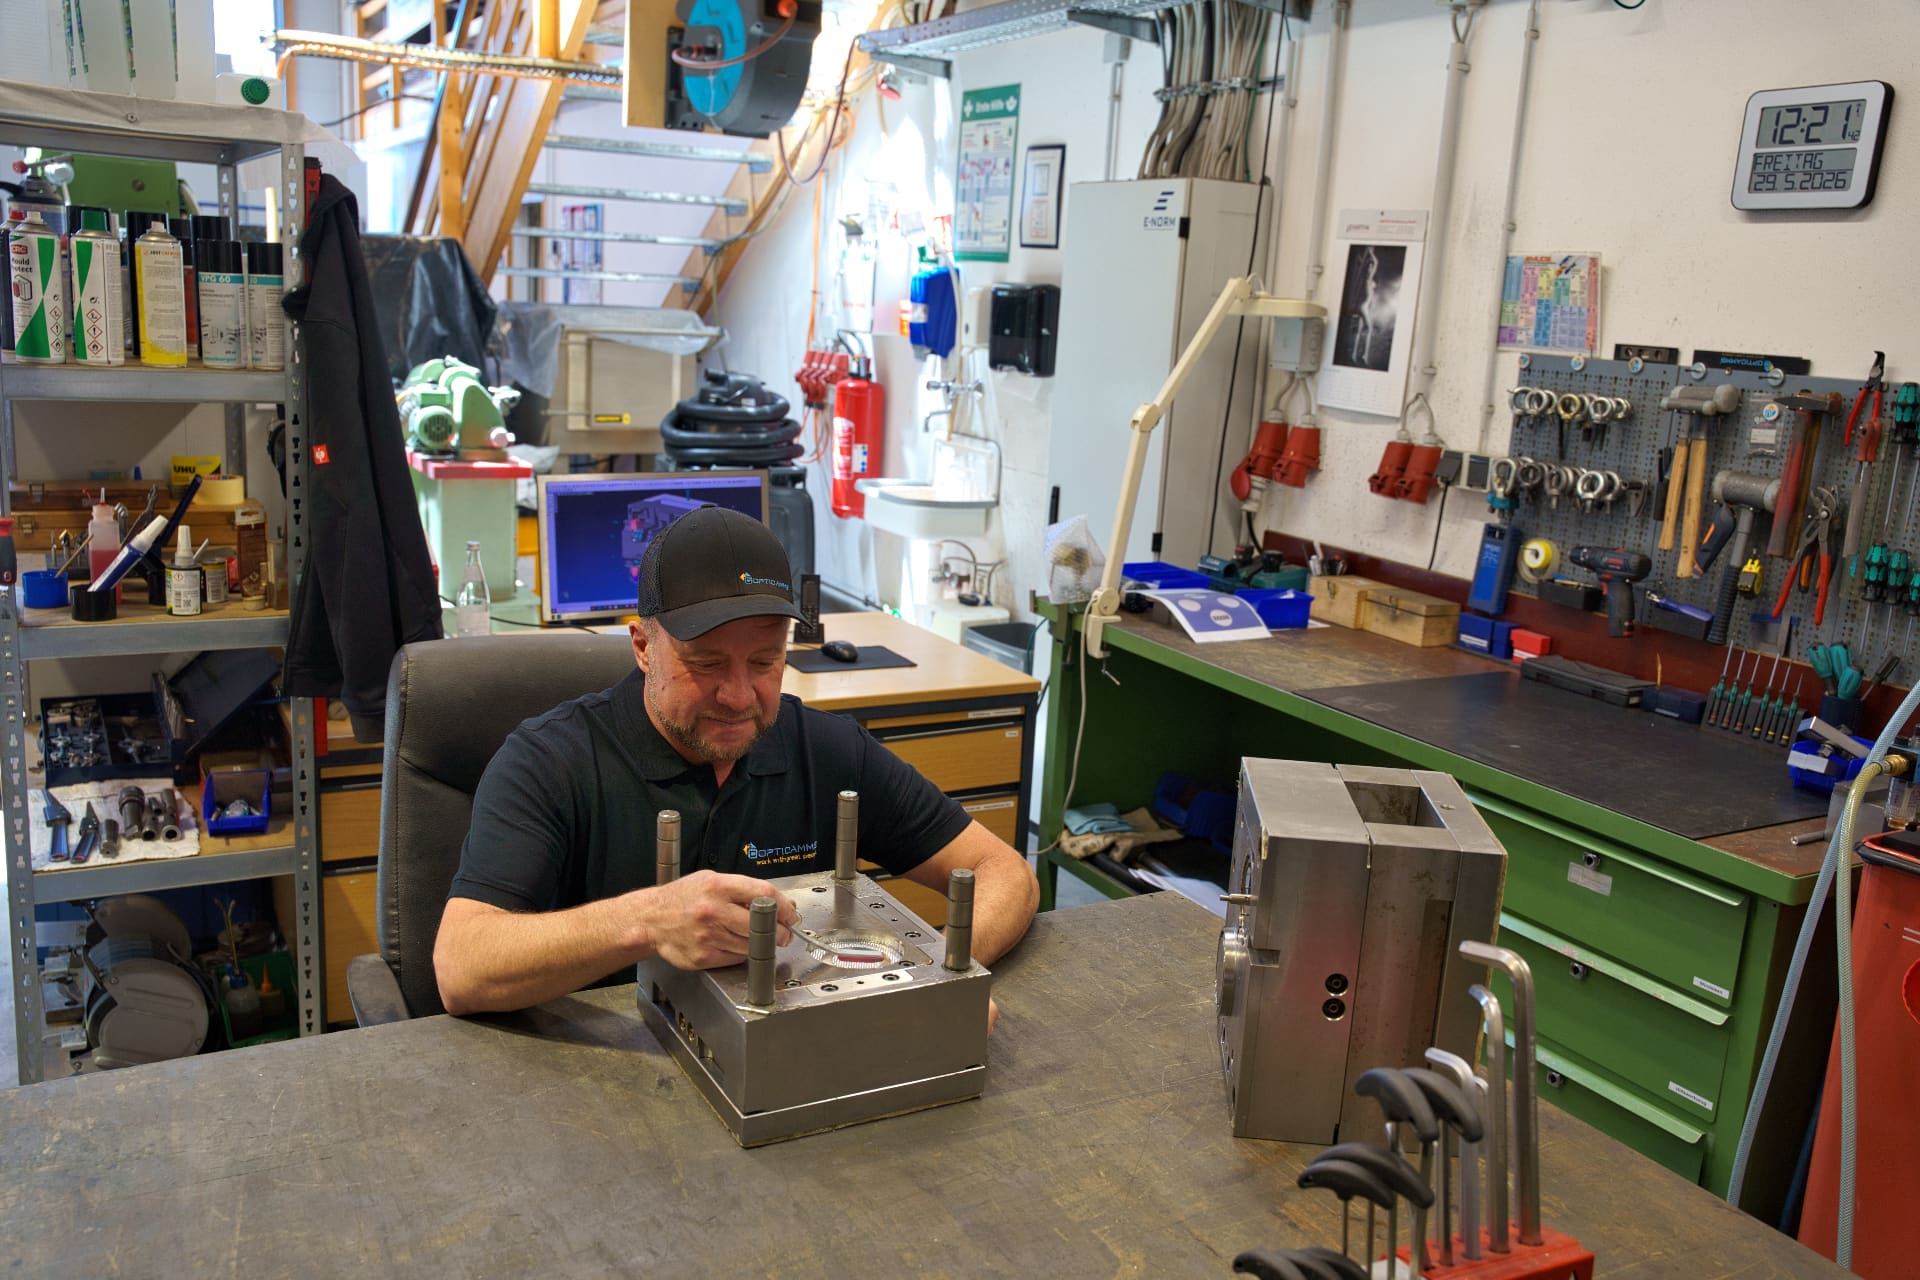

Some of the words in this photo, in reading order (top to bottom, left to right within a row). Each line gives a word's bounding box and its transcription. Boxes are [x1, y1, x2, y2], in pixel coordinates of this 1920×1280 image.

[1772, 104, 1853, 145] 12:21
[1754, 152, 1824, 172] FREITAG
[218, 274, 231, 283] 60
[173, 465, 196, 474] UHU
